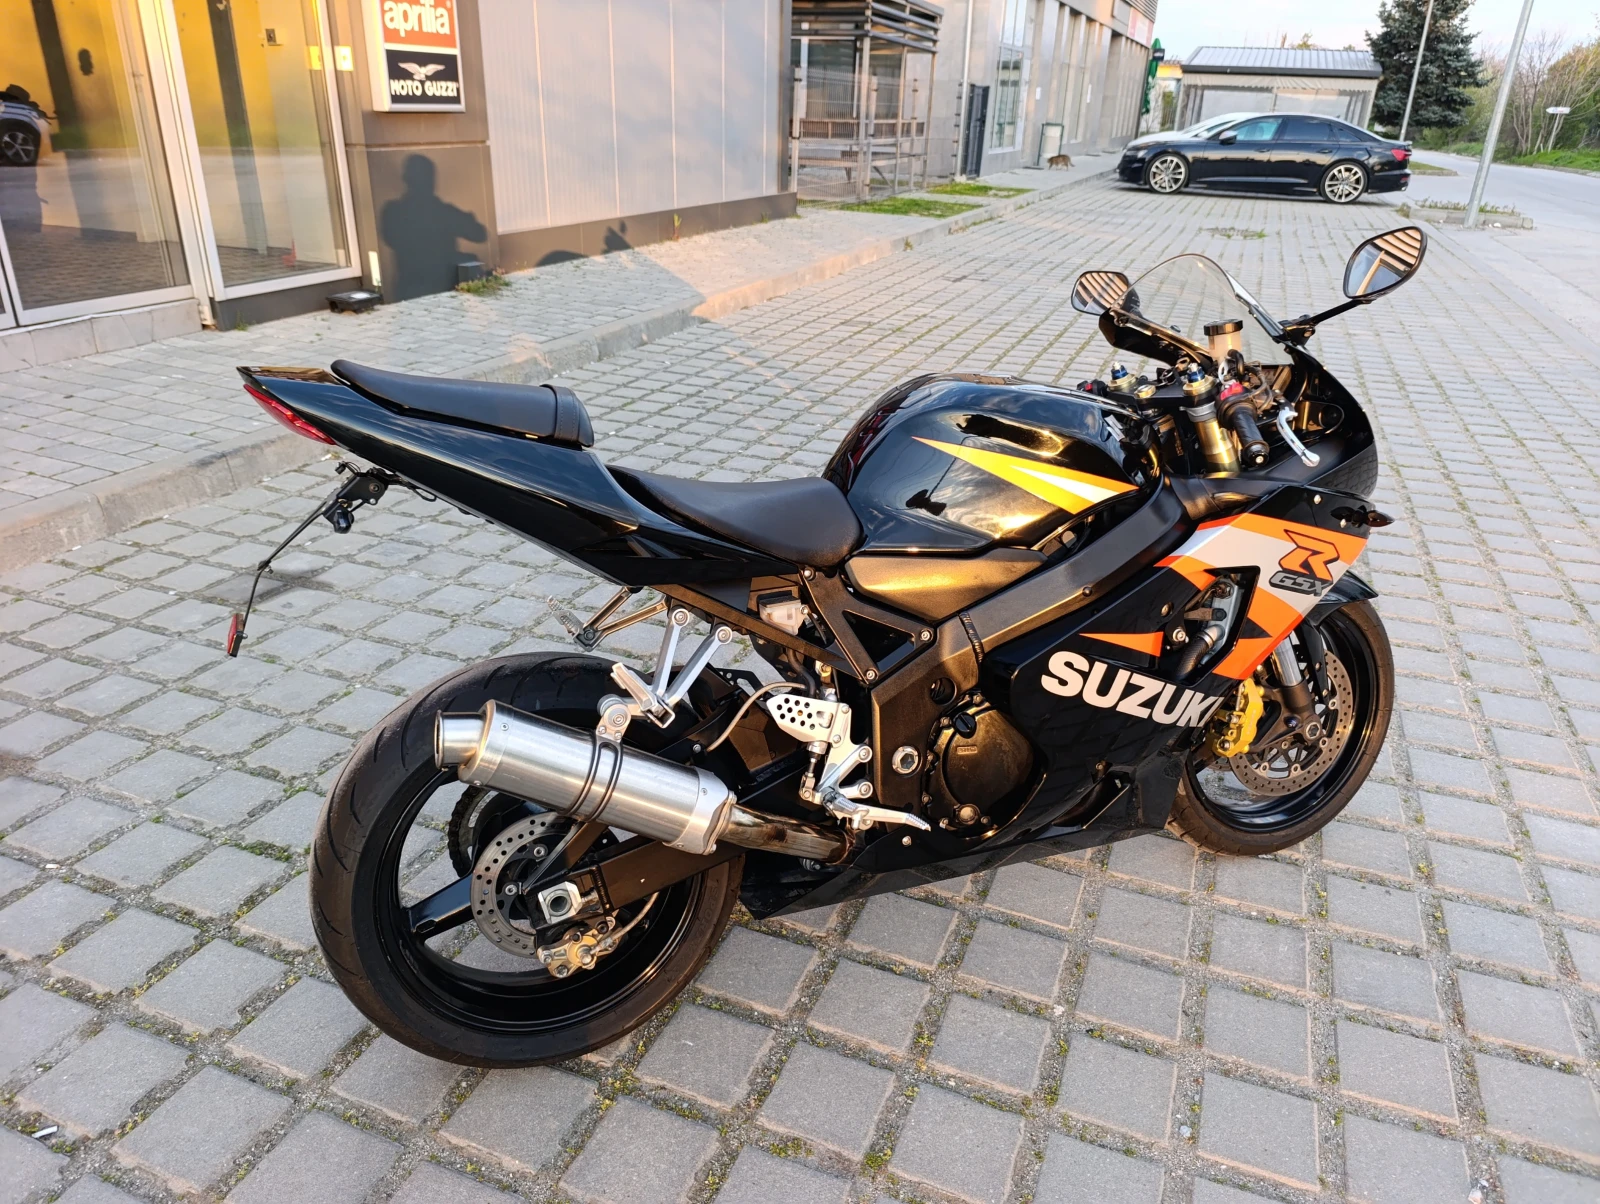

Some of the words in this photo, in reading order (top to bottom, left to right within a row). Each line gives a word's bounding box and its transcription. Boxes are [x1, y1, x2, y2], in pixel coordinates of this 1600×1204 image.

[383, 0, 450, 37] aprilia
[390, 79, 422, 96] MOTO
[424, 81, 458, 97] GUZZI
[1279, 529, 1340, 582] R
[1268, 570, 1333, 596] GSX
[1041, 651, 1225, 727] SUZUKI
